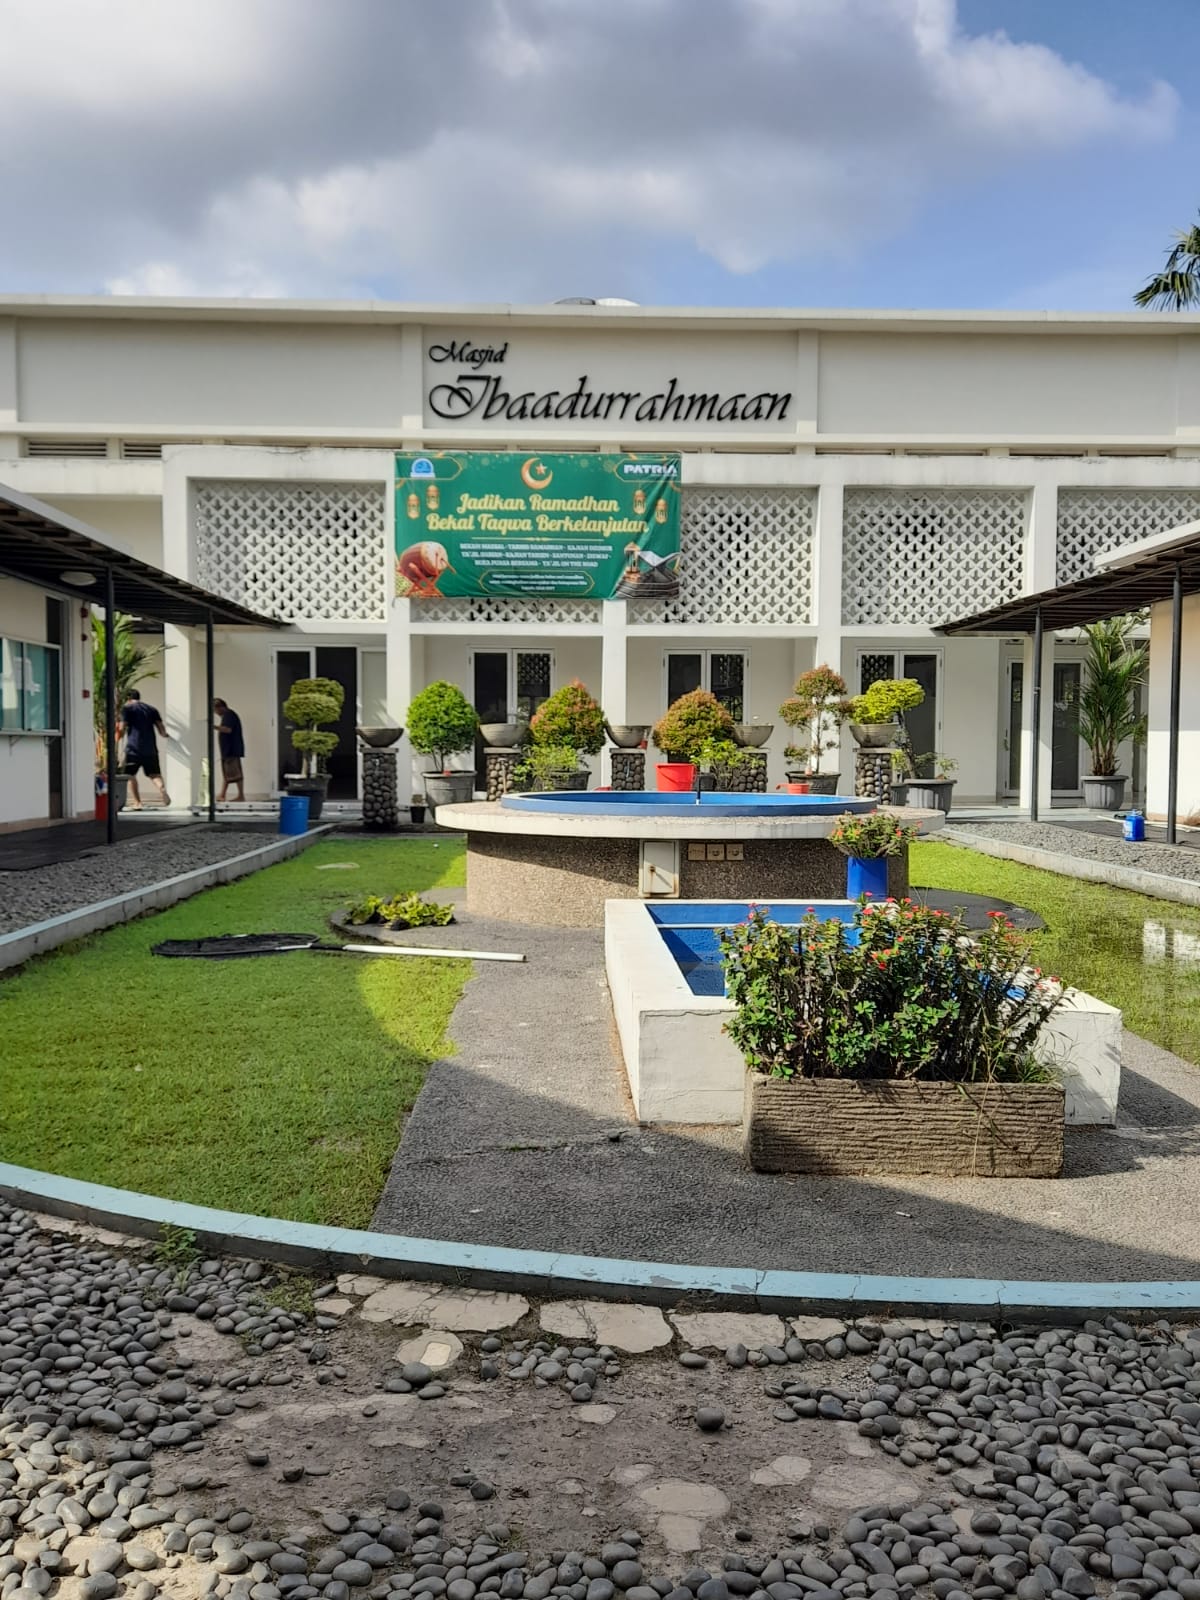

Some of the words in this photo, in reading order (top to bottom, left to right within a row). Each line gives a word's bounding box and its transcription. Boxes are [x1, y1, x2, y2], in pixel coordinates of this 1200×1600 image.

[429, 341, 508, 370] Masjid
[429, 375, 792, 421] Ibaadurrahmaan
[623, 464, 678, 474] PATRIA
[456, 493, 526, 514] Jadikan
[529, 494, 620, 512] Ramadhan
[426, 513, 475, 531] Bekal
[477, 514, 532, 535] Taqwa
[535, 514, 650, 537] Berkelanjutan
